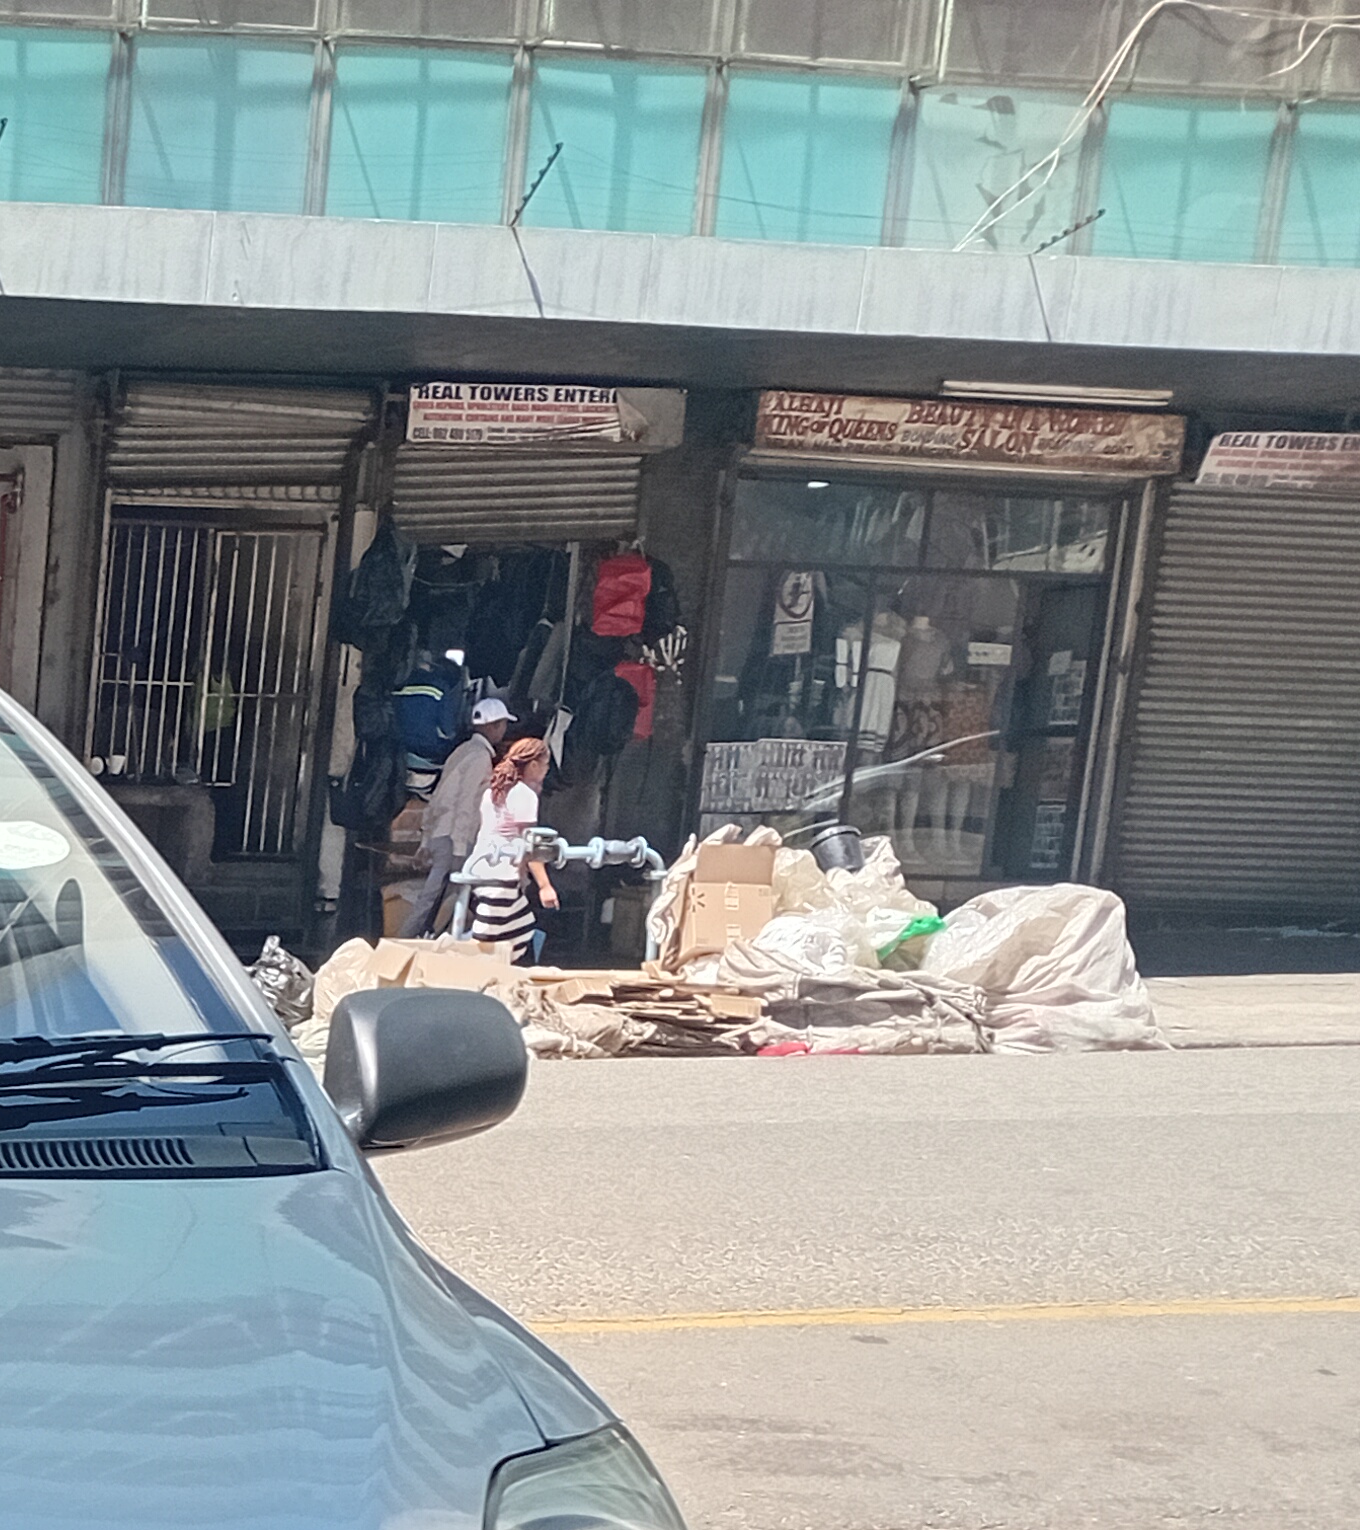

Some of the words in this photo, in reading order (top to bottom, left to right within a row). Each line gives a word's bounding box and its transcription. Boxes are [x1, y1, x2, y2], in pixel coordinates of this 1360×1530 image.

[416, 385, 463, 400] REAL
[468, 386, 549, 402] TOWERS
[1218, 434, 1259, 447] REAL
[1265, 435, 1338, 450] TOWERS
